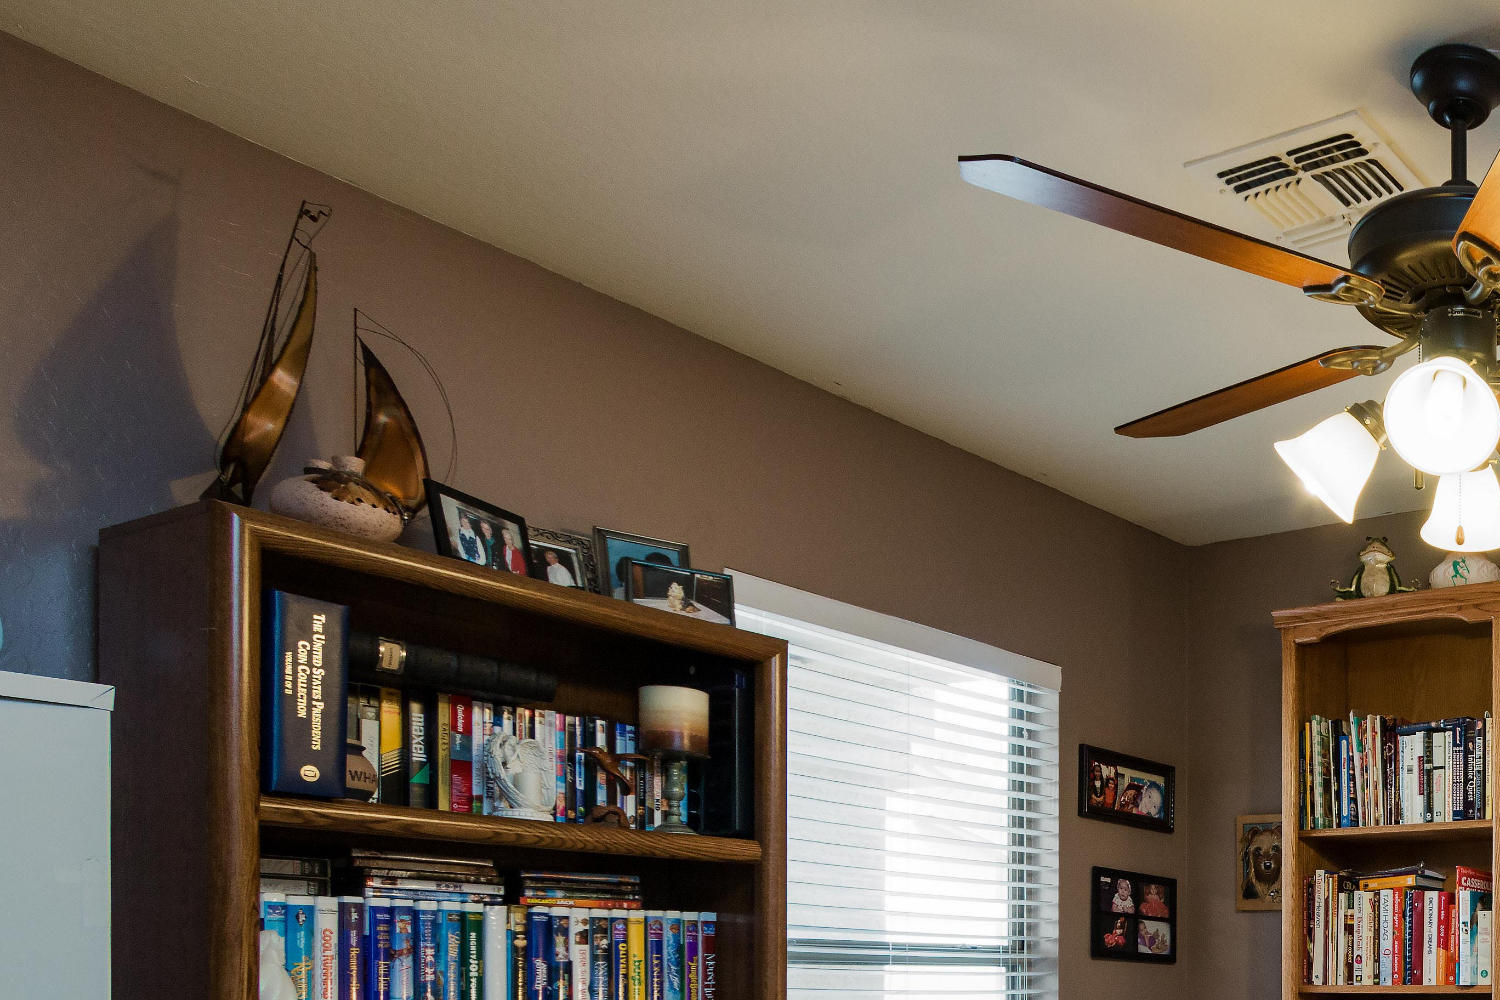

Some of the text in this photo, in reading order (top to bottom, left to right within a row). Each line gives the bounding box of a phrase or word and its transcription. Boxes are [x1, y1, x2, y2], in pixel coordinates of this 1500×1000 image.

[311, 633, 326, 668] UNITED
[296, 640, 311, 719] COIN COLLECTION
[310, 667, 325, 700] STATES
[310, 700, 325, 751] PRESIDENTS
[411, 712, 427, 761] maxell
[1466, 754, 1475, 801] Infinite Quest
[321, 928, 334, 954] COOL
[469, 933, 478, 959] MIGHTY
[469, 958, 479, 977] JOE
[618, 943, 628, 975] OLIVER
